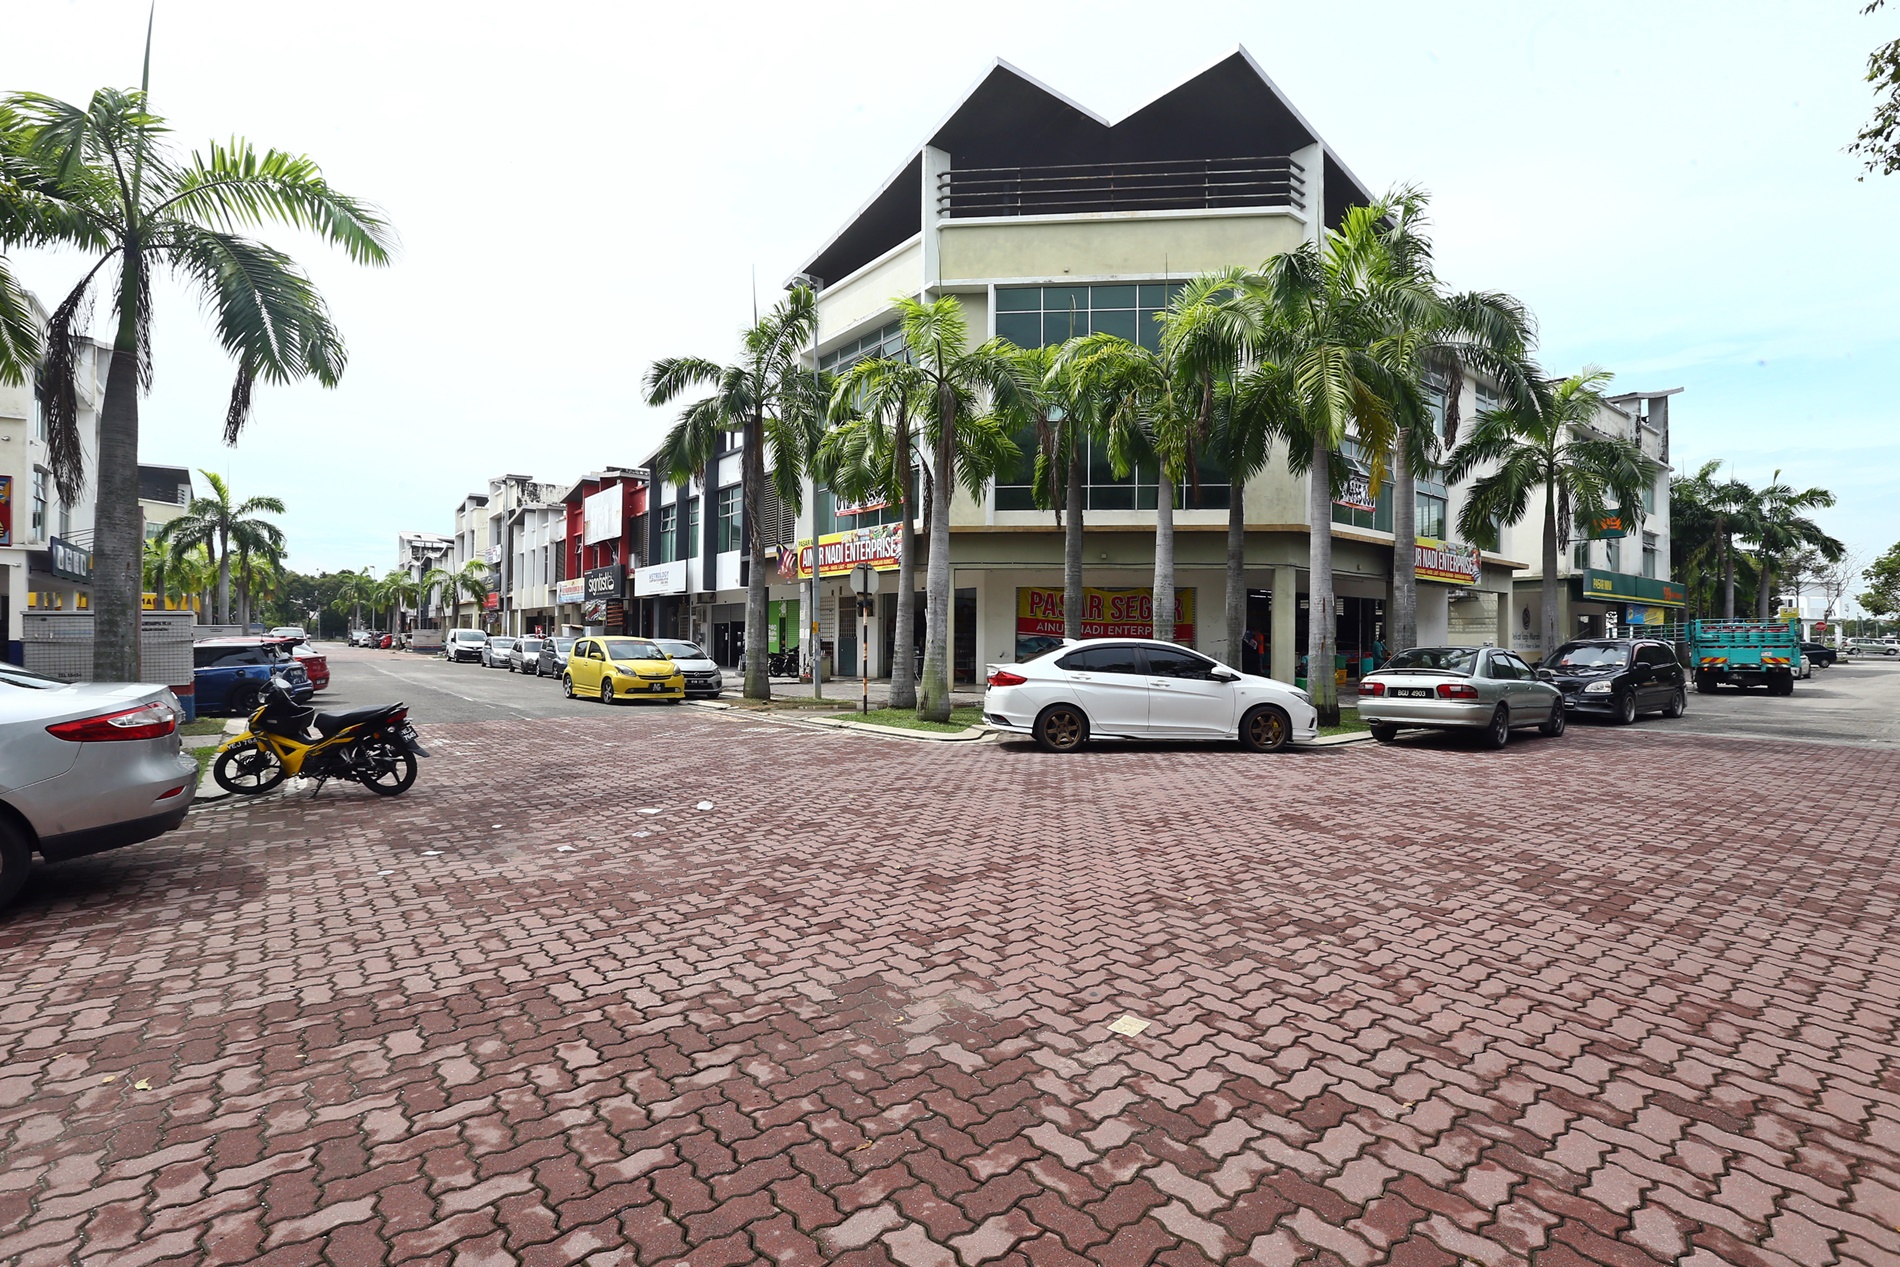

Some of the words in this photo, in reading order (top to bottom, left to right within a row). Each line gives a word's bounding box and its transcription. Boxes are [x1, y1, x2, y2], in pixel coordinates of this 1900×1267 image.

[802, 547, 824, 567] AINR
[825, 543, 844, 564] NADI
[845, 537, 896, 562] ENTERPRISE
[1422, 549, 1438, 569] NADI
[1439, 552, 1473, 574] ENTERPRISE
[1110, 594, 1184, 622] SEGR
[1036, 622, 1065, 632] AINU
[1108, 625, 1177, 636] ENTERP
